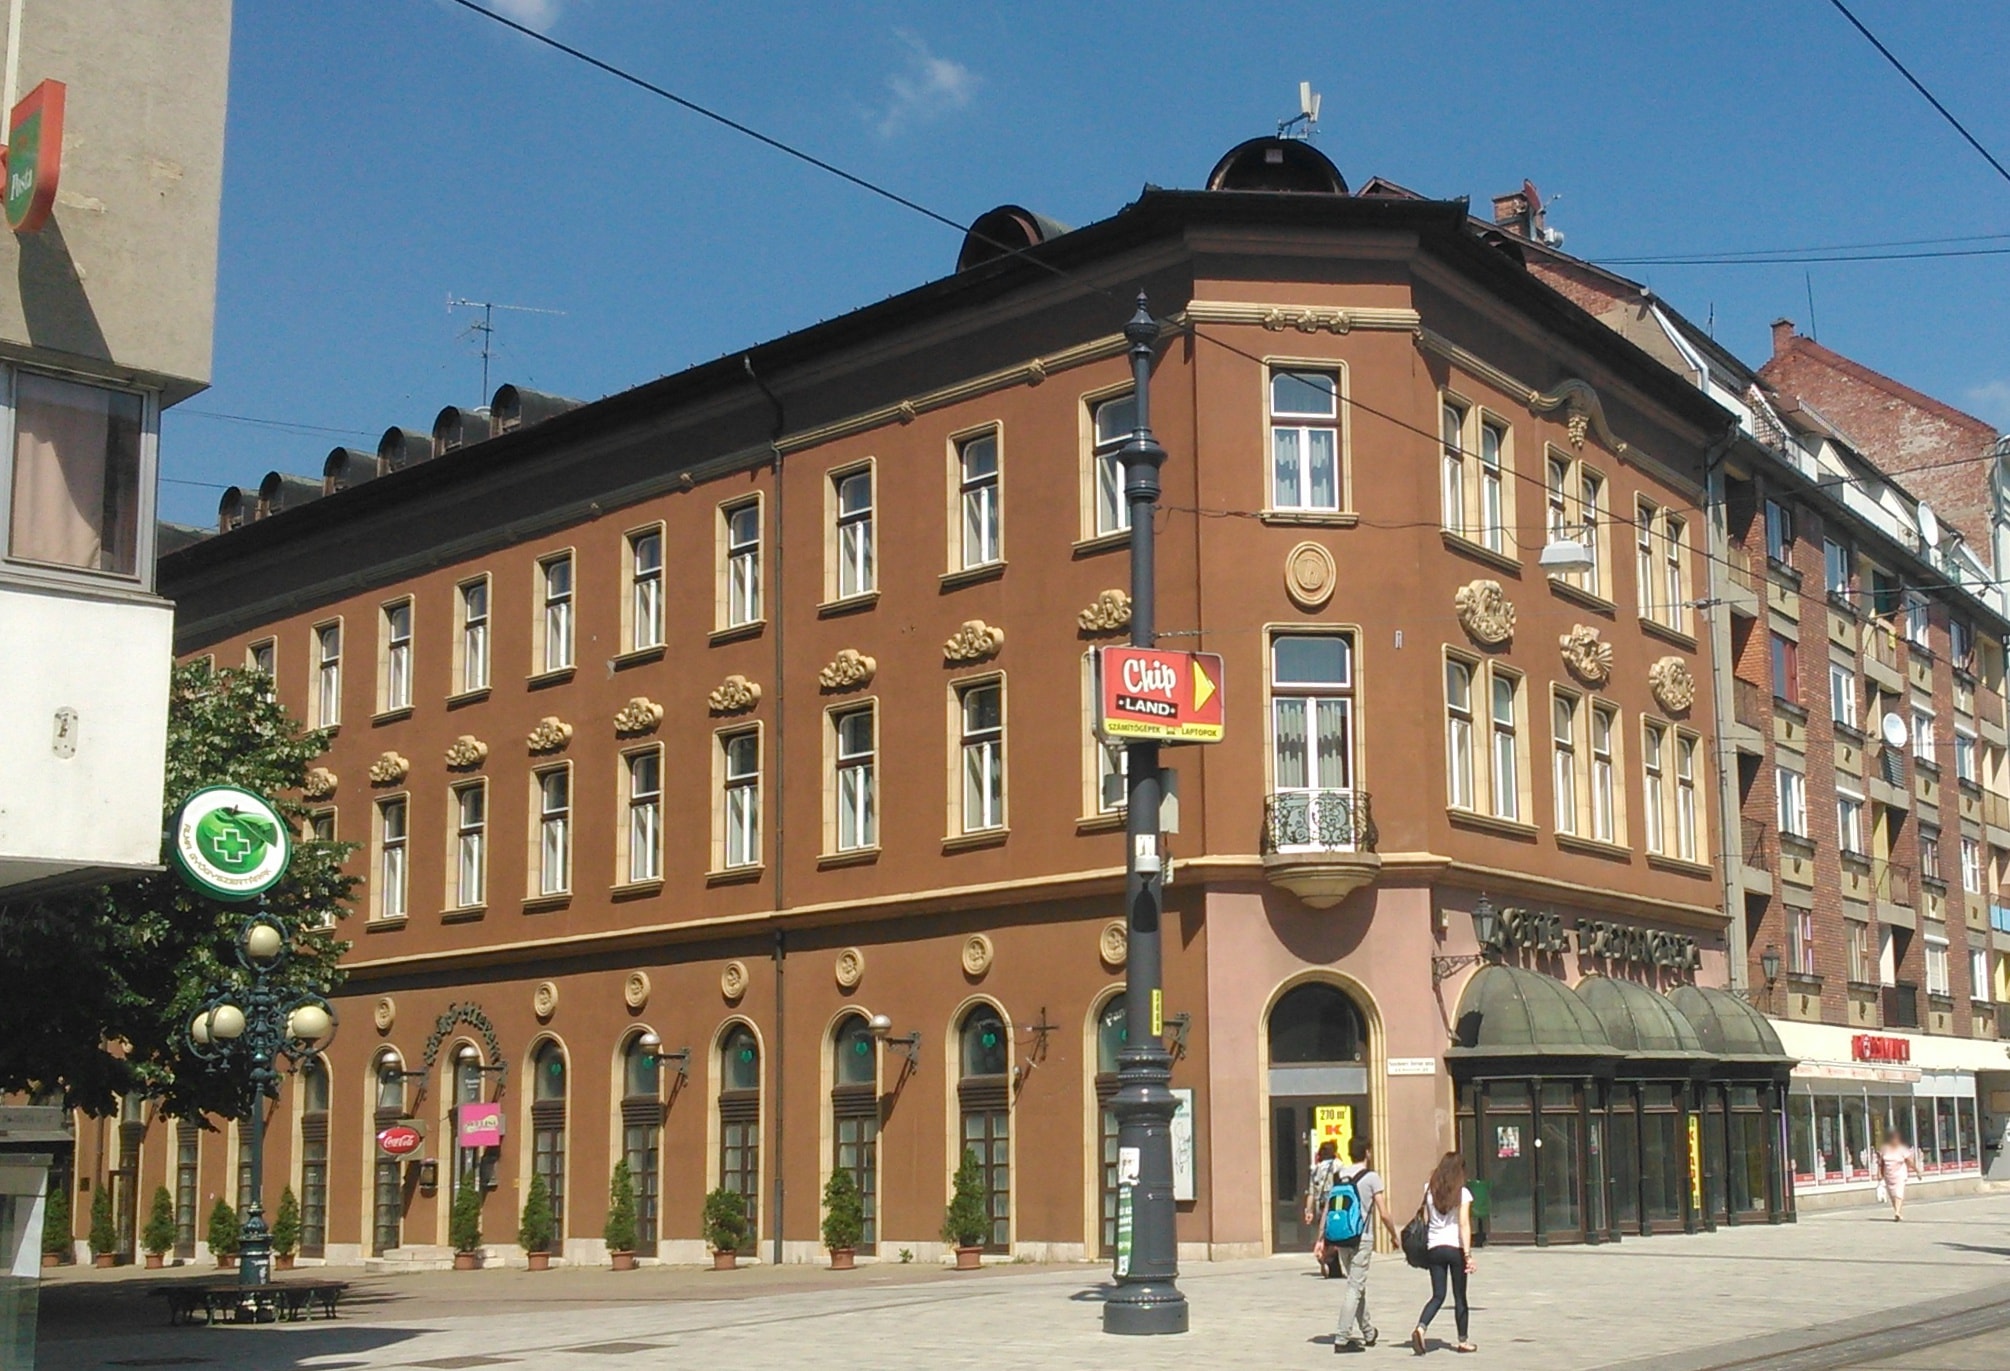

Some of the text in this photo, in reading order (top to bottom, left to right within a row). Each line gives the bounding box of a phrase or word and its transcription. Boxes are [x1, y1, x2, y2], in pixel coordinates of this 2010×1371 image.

[1123, 658, 1177, 698] Chip
[1125, 697, 1170, 716] LAND
[1181, 727, 1217, 737] LAPTOPOK
[1320, 1109, 1335, 1120] 270
